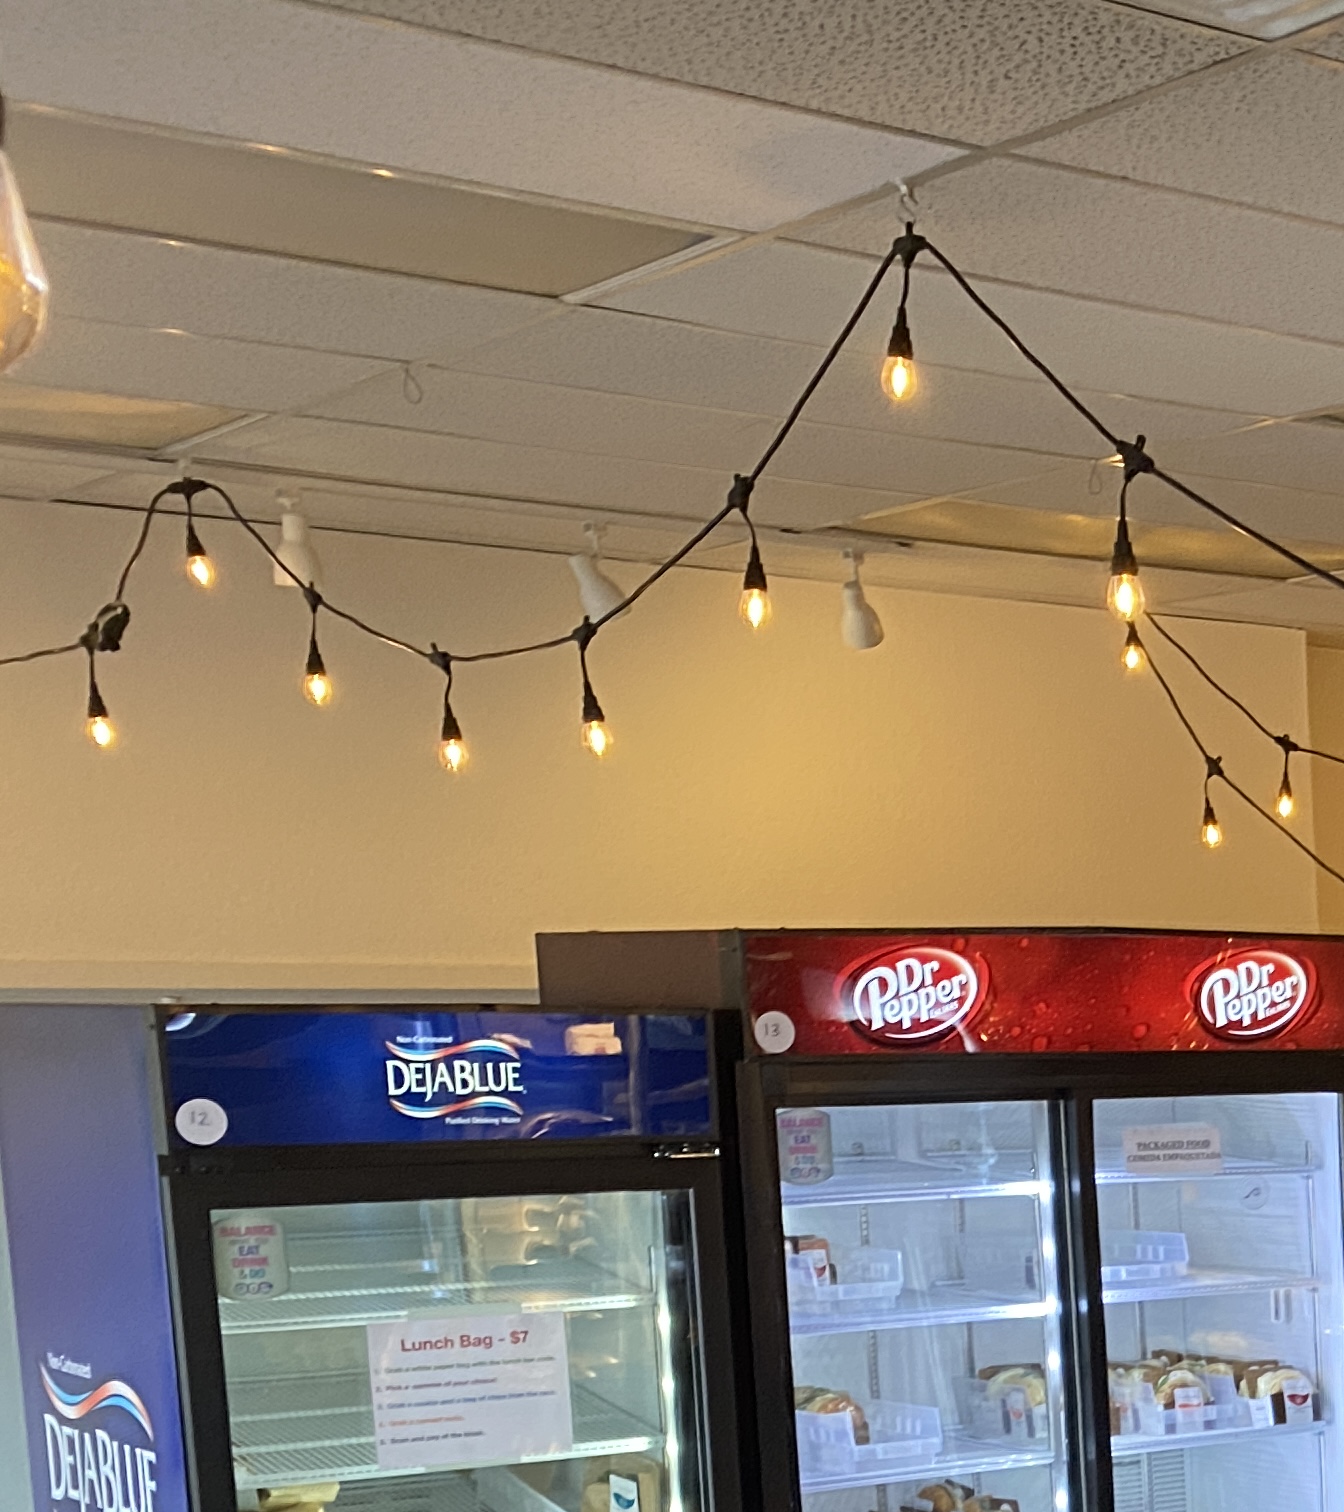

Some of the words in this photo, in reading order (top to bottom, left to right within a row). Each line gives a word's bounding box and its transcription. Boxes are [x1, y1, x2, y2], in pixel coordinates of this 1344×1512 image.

[896, 958, 940, 996] Dr
[1237, 961, 1275, 995] Dr
[853, 965, 967, 1031] Pepper
[1201, 968, 1298, 1028] Pepper
[764, 1023, 781, 1037] 13
[190, 1111, 210, 1127] 12
[401, 1336, 454, 1352] Lunch
[459, 1334, 493, 1348] Bag
[509, 1330, 529, 1344] $7
